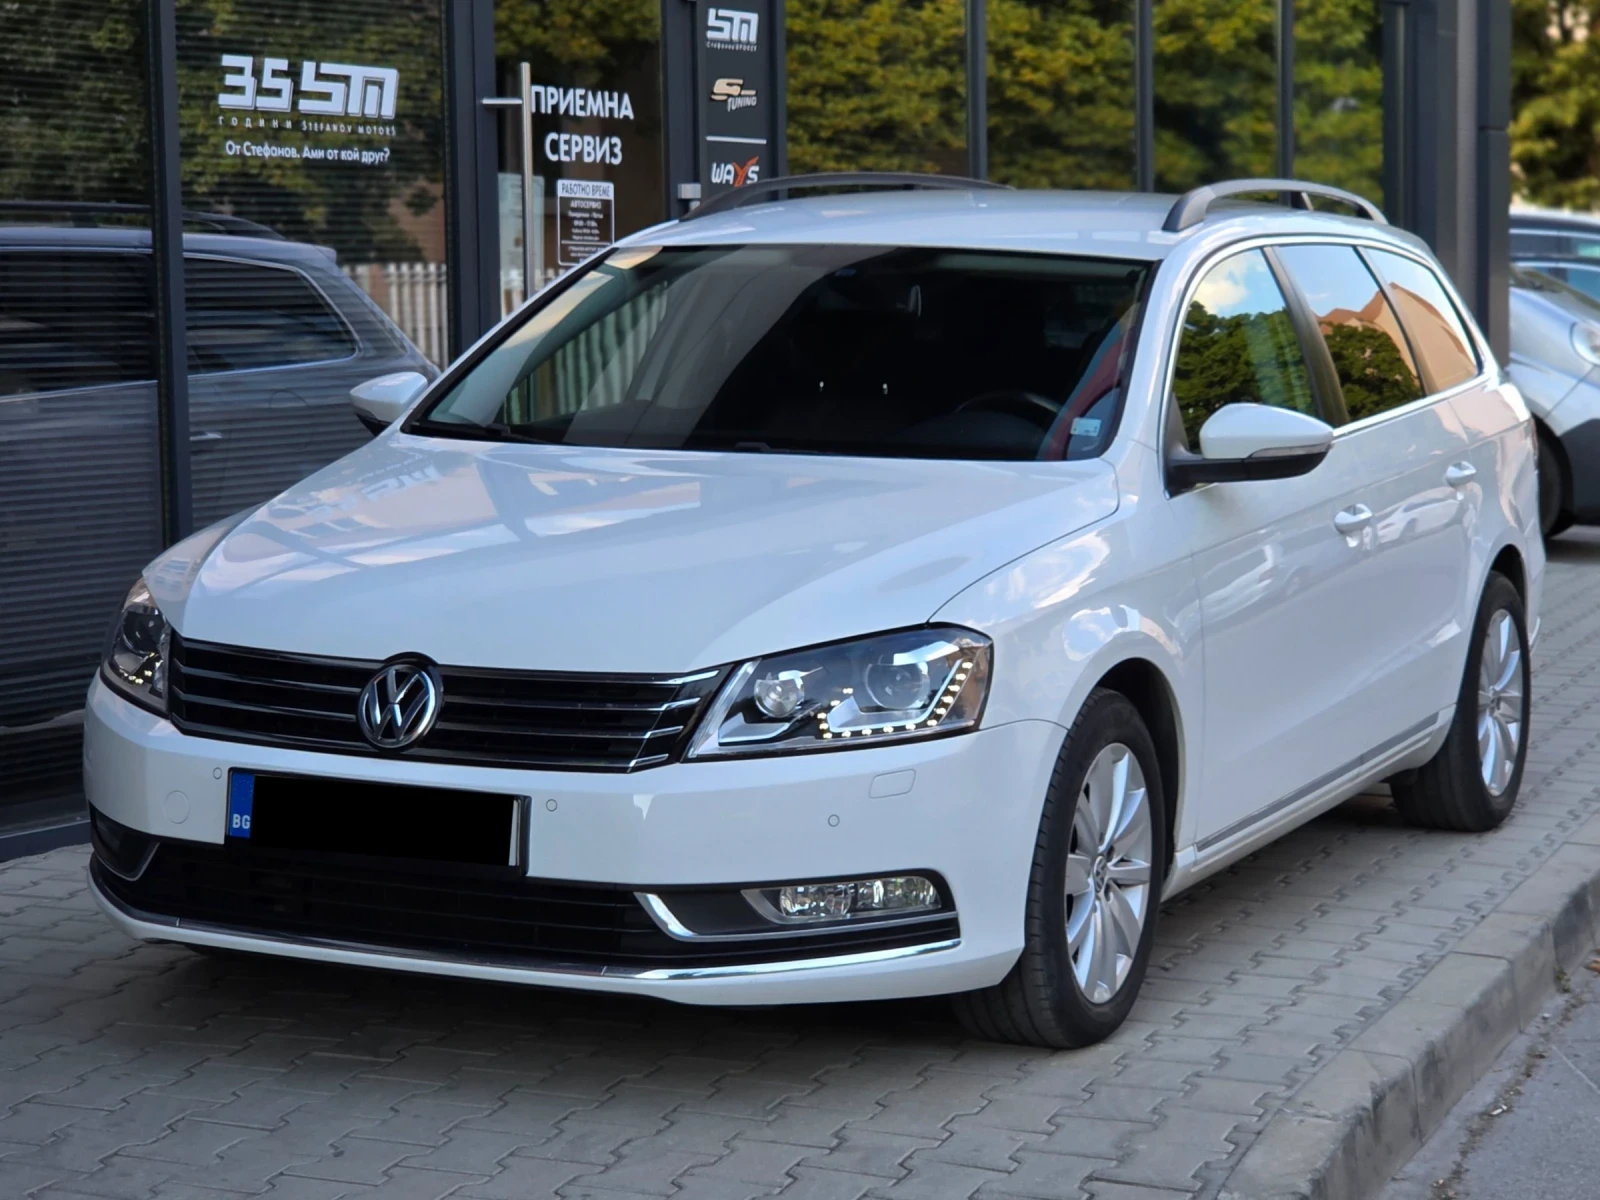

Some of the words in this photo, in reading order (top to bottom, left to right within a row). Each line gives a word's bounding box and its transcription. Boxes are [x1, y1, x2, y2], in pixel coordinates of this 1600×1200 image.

[218, 54, 295, 112] 35
[531, 85, 634, 120] ПРИЕМНА
[218, 116, 292, 129] ГОДИНИ
[225, 140, 241, 156] От
[243, 141, 300, 159] Стефанов.
[302, 146, 325, 160] Ами
[327, 148, 339, 161] от
[341, 147, 360, 162] кой
[361, 147, 390, 164] друг?
[545, 132, 622, 165] СЕРВИЗ
[711, 156, 759, 187] WAYS
[562, 182, 590, 196] РАБОТНО
[592, 184, 611, 198] ВРЕМЕ
[232, 813, 251, 829] BG
